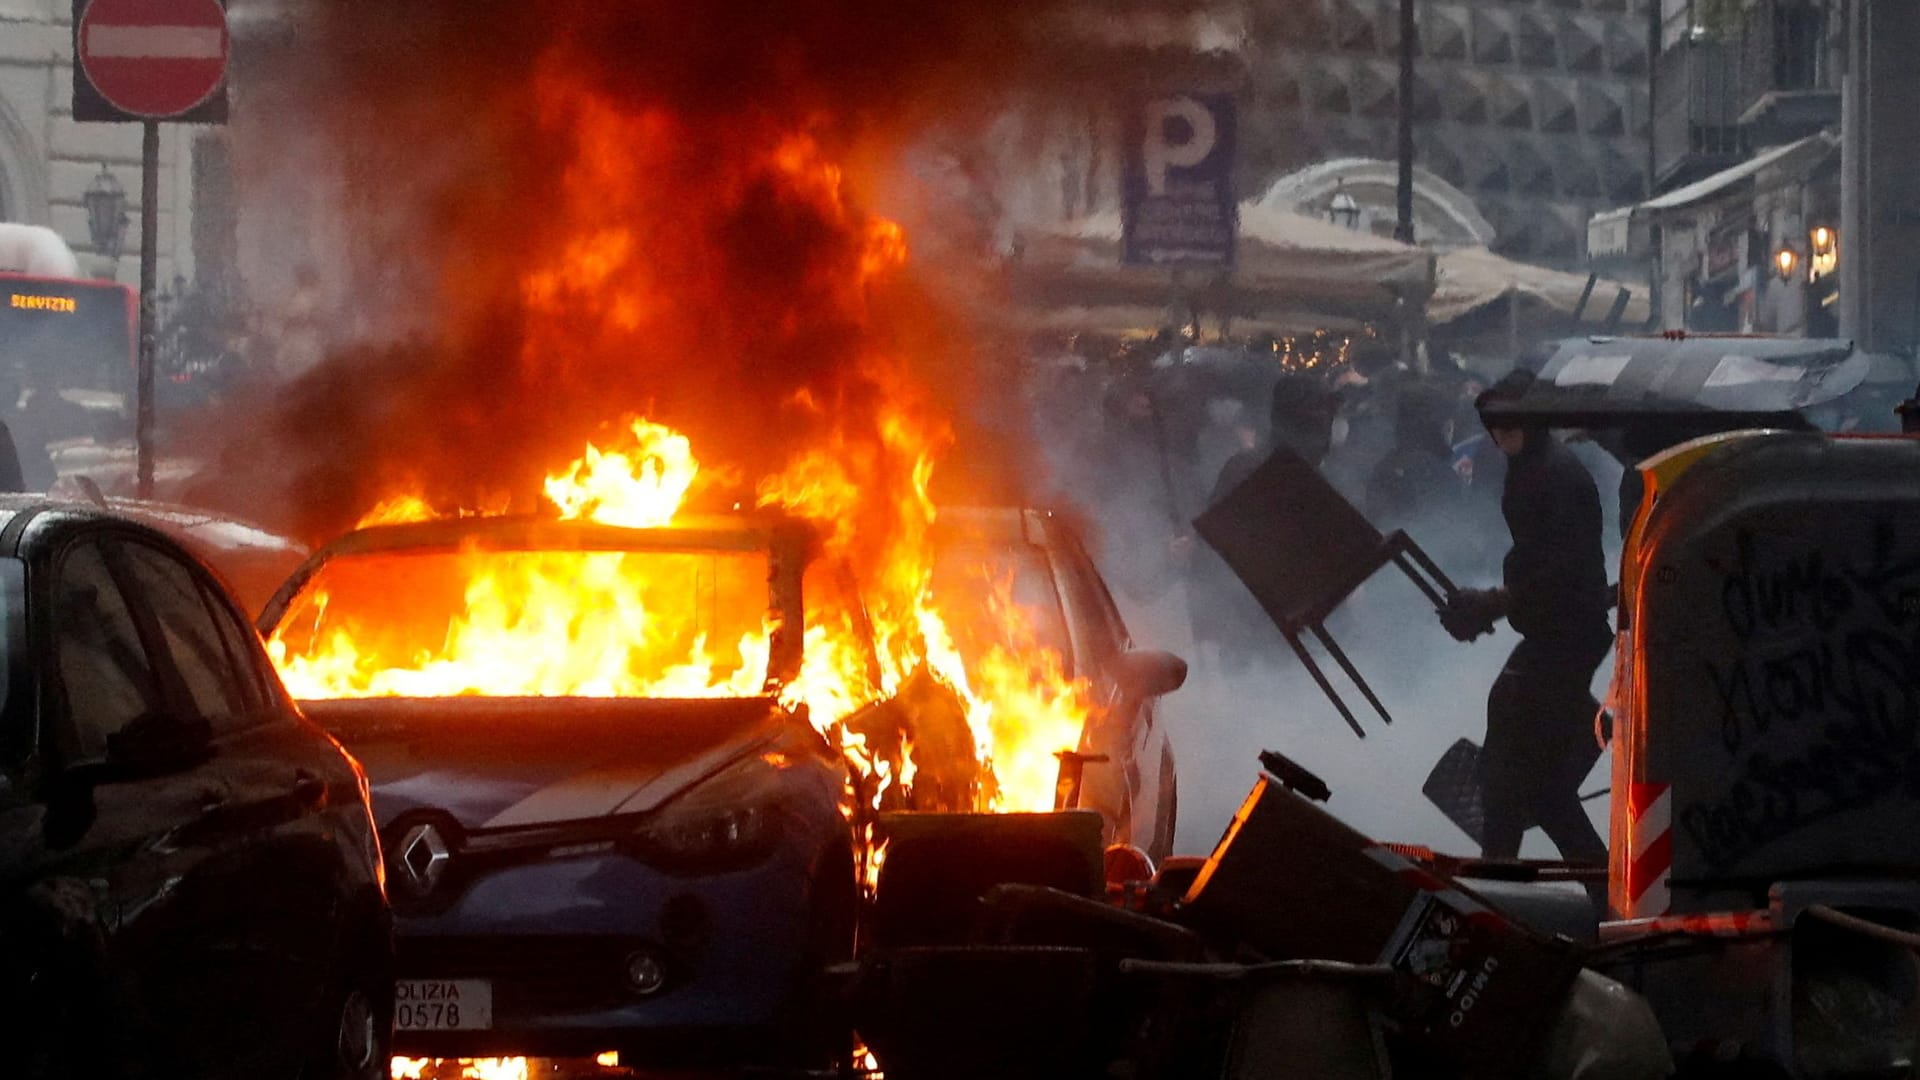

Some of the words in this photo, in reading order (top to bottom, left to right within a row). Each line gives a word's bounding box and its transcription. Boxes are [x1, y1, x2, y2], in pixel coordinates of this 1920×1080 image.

[1143, 95, 1216, 197] P
[395, 983, 459, 1000] OLIZIA
[398, 1003, 460, 1028] 0578
[1450, 956, 1498, 1027] UMIDO
